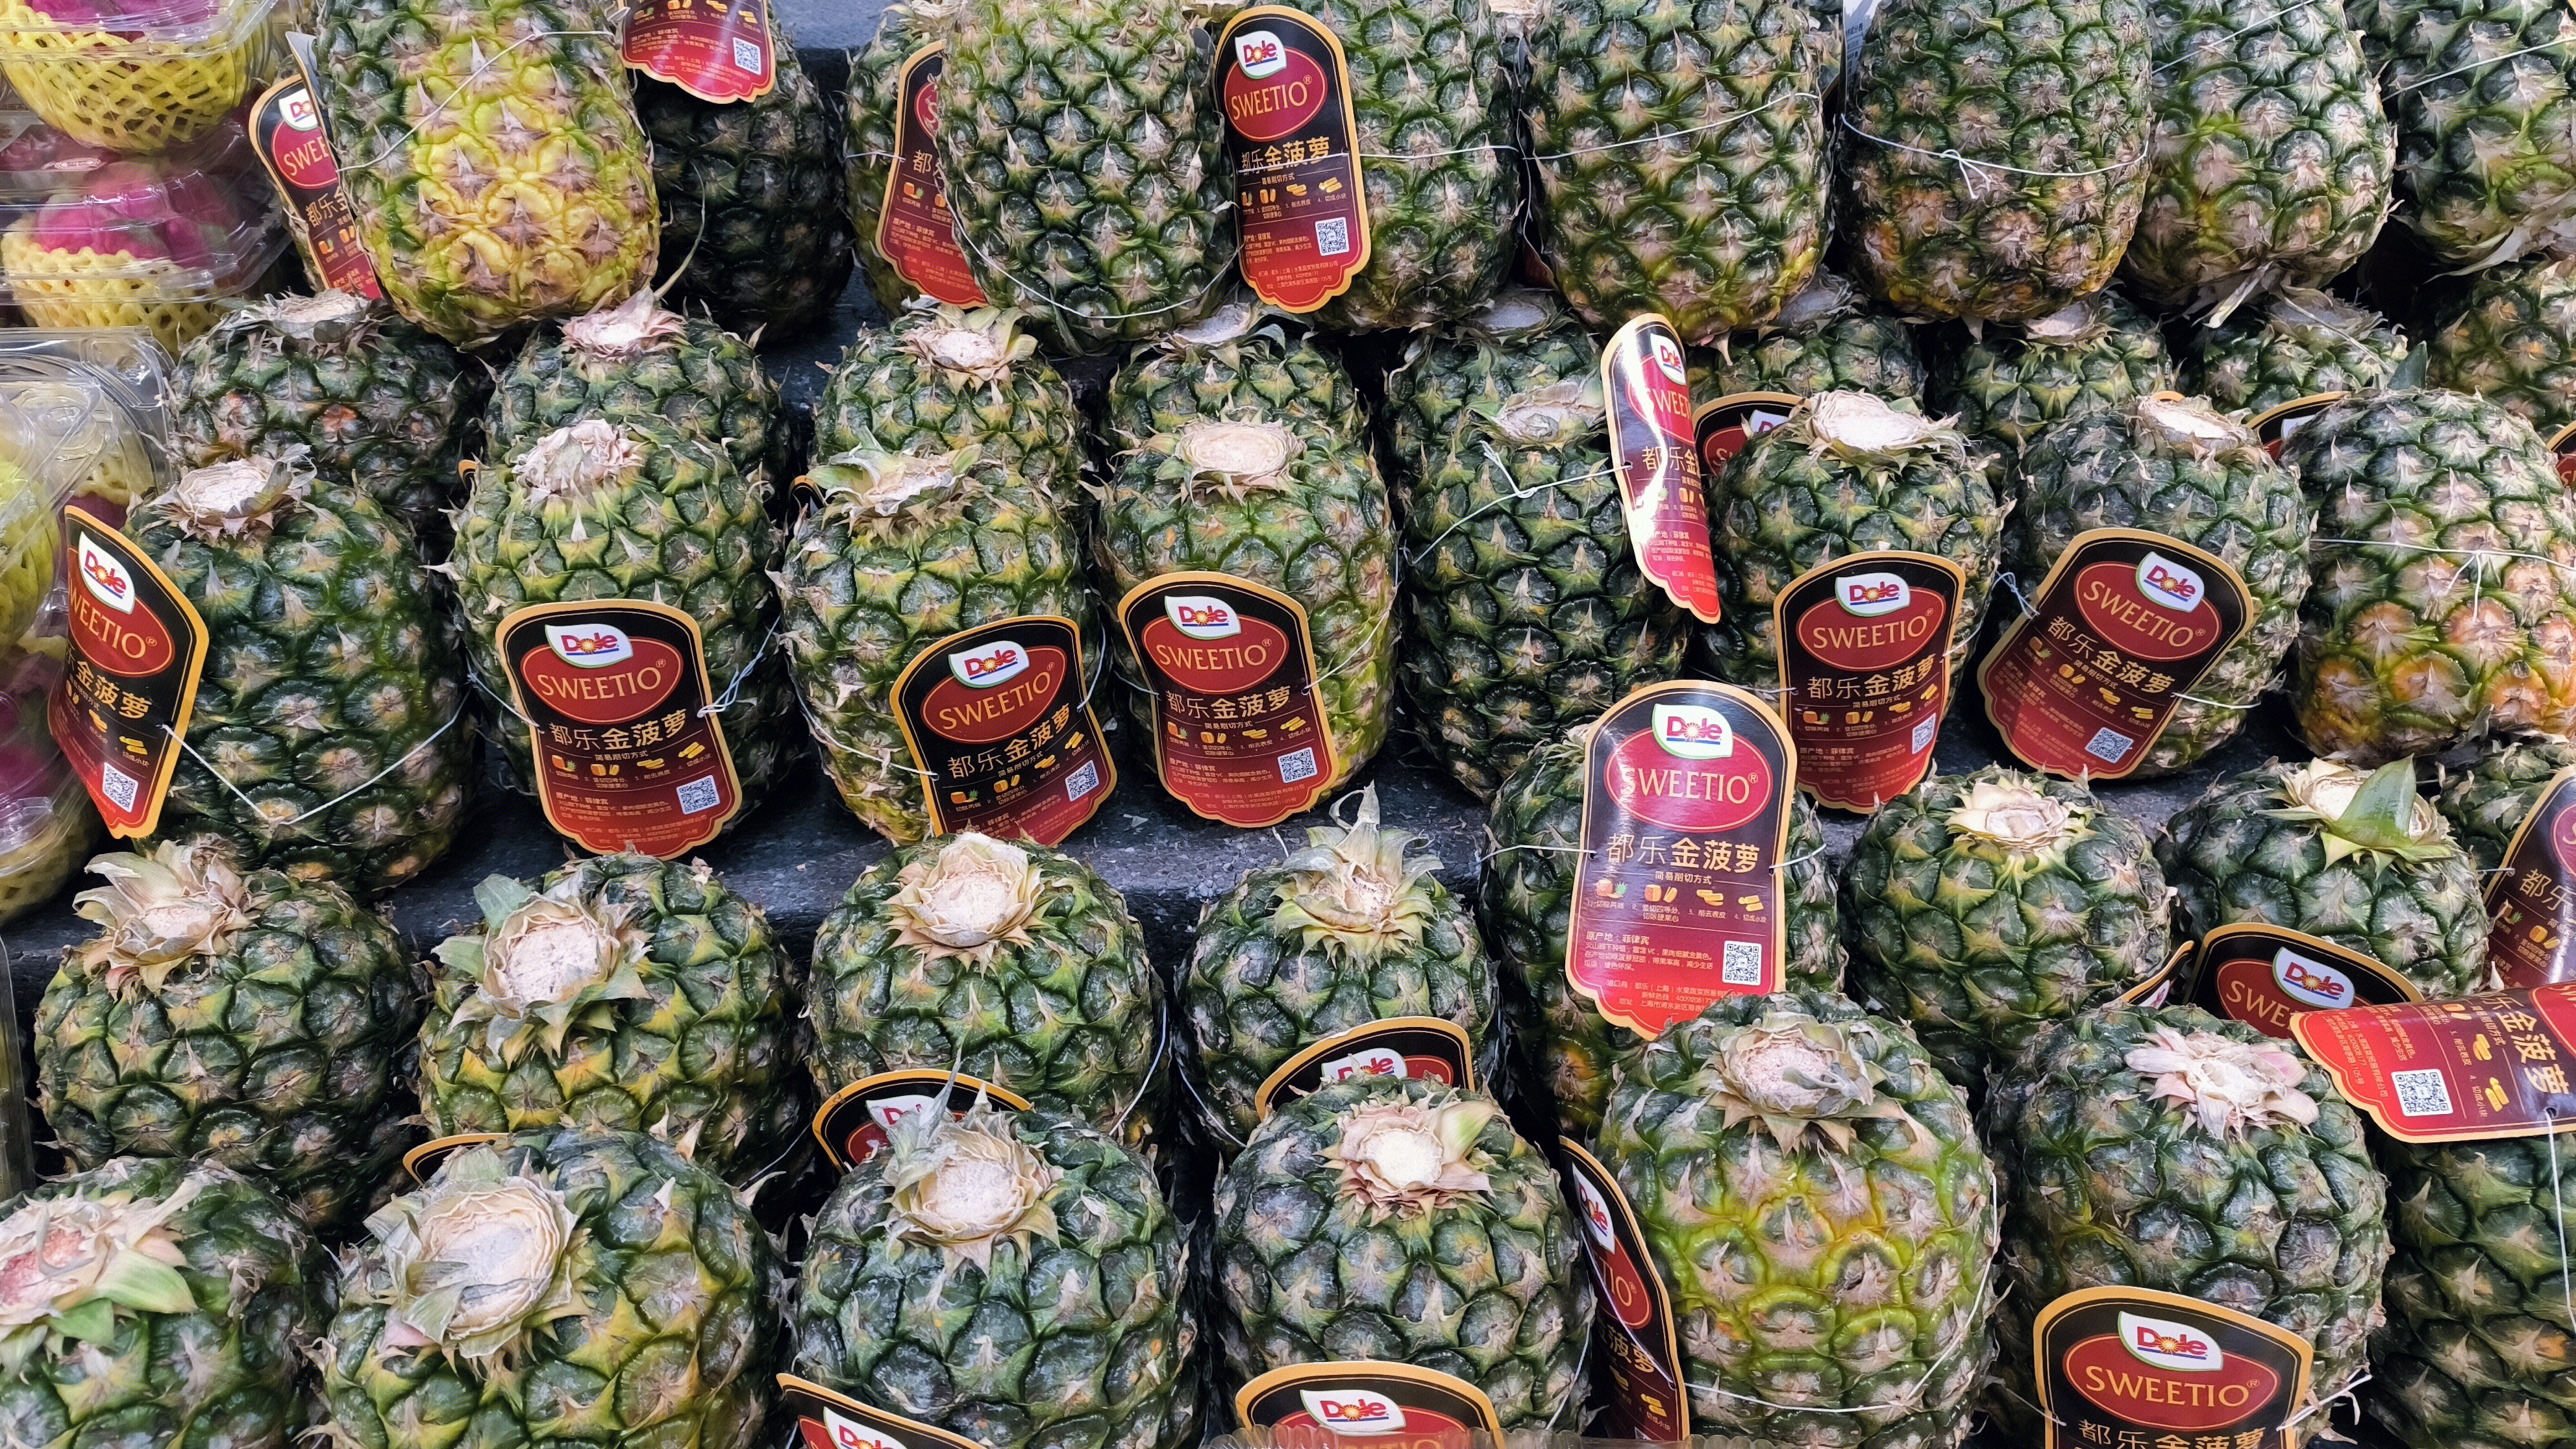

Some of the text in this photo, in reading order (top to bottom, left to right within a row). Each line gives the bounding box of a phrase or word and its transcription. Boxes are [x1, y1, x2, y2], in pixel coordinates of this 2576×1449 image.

[1243, 40, 1277, 63] Dole
[1231, 81, 1307, 120] SWEETIO
[84, 549, 128, 597] Dole
[2146, 564, 2197, 598] Dole
[1850, 581, 1900, 602] Dole
[68, 582, 146, 659] WEETIO
[1178, 605, 1228, 626] Dole
[2083, 580, 2194, 648] SWEETIO
[561, 632, 619, 653] Dole
[1813, 615, 1927, 649] SWEETIO
[964, 649, 1017, 676] Dole
[1156, 643, 1268, 671] SWEETIO
[2047, 615, 2175, 694] 都乐金菠萝
[538, 666, 662, 700] SWEETIO
[1807, 653, 1937, 699] 都乐金菠萝
[939, 671, 1051, 730] SWEETIO
[1165, 685, 1291, 720] 都乐金菠萝
[549, 708, 687, 750] 都乐金菠萝
[947, 703, 1070, 779] 都乐金菠萝
[1667, 716, 1722, 742] Dole
[1619, 767, 1750, 805] SWEETIO
[1605, 833, 1761, 874] 都乐金菠萝
[2285, 962, 2344, 996] Dole
[2137, 1326, 2208, 1354] Dole
[2086, 1365, 2248, 1407] SWEETIO
[1320, 1399, 1387, 1420] Dole
